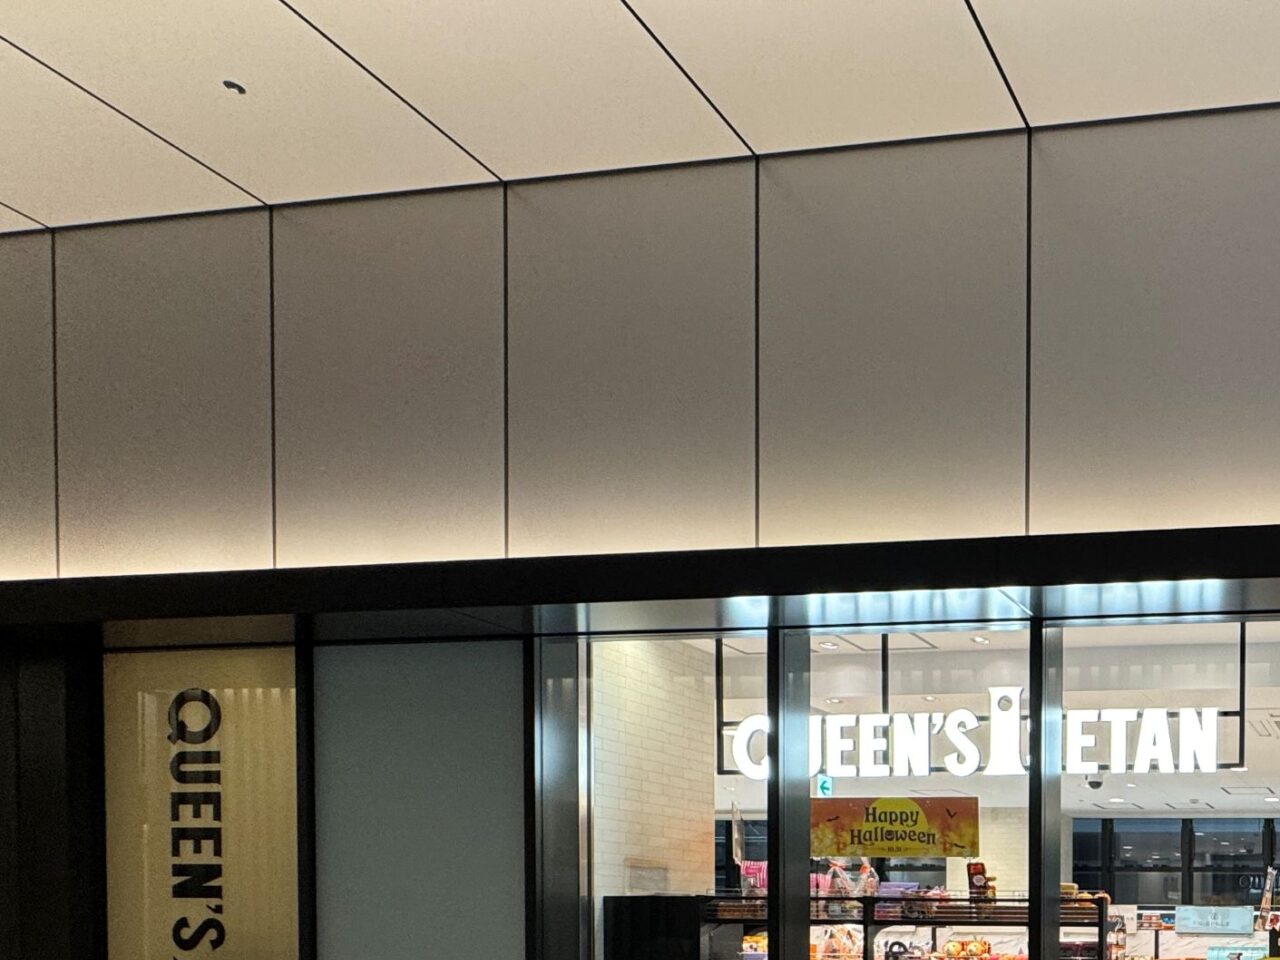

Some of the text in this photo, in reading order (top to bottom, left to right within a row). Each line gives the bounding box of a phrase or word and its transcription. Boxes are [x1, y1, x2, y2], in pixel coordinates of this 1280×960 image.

[983, 686, 1219, 776] IETAN
[167, 688, 226, 951] QUEEN'S
[850, 827, 936, 846] Halloween
[864, 806, 919, 827] Happy
